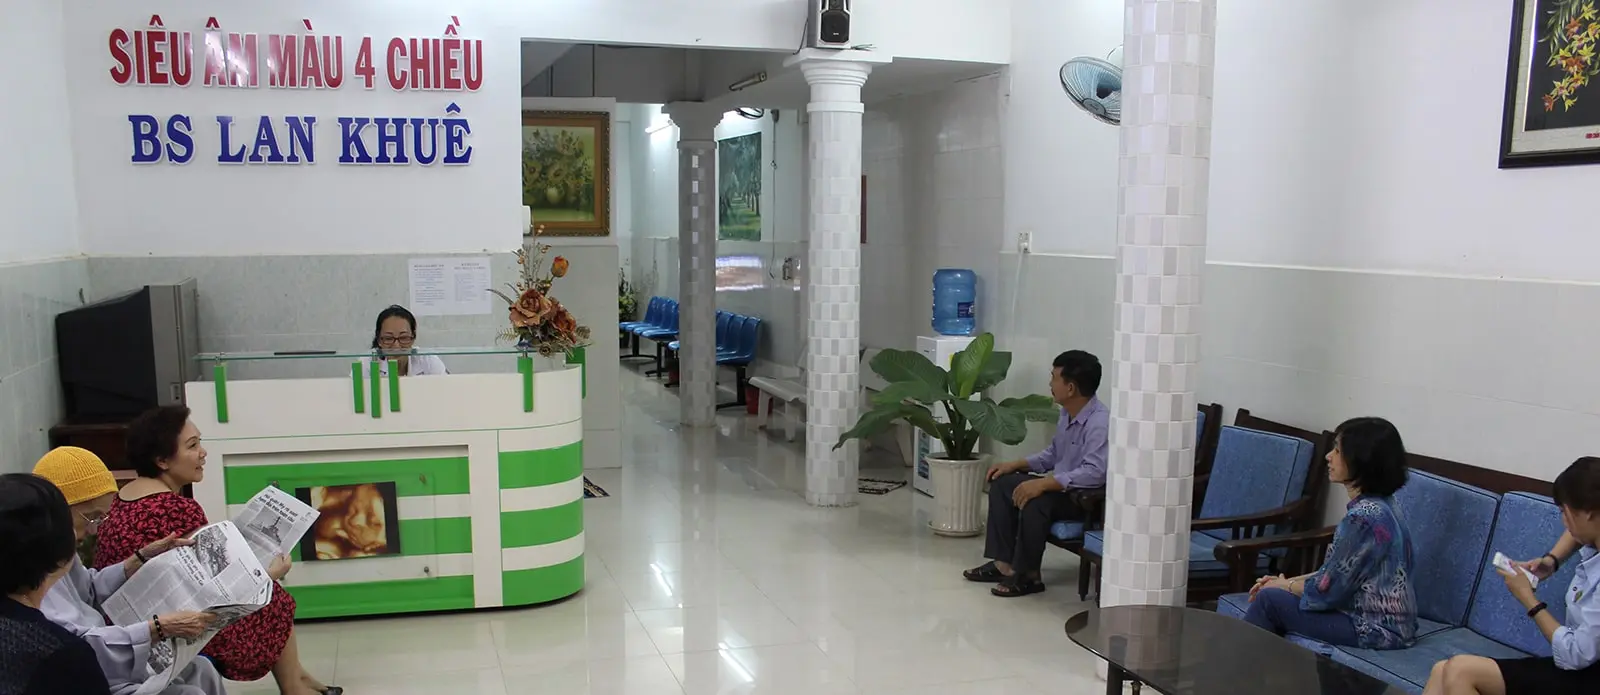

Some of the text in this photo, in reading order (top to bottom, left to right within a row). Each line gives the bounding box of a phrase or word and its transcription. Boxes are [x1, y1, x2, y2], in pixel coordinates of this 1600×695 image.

[109, 14, 483, 92] SIÊU ÂM MÀU 4 CHIỀU
[127, 102, 473, 165] BS LAN KHUÊ
